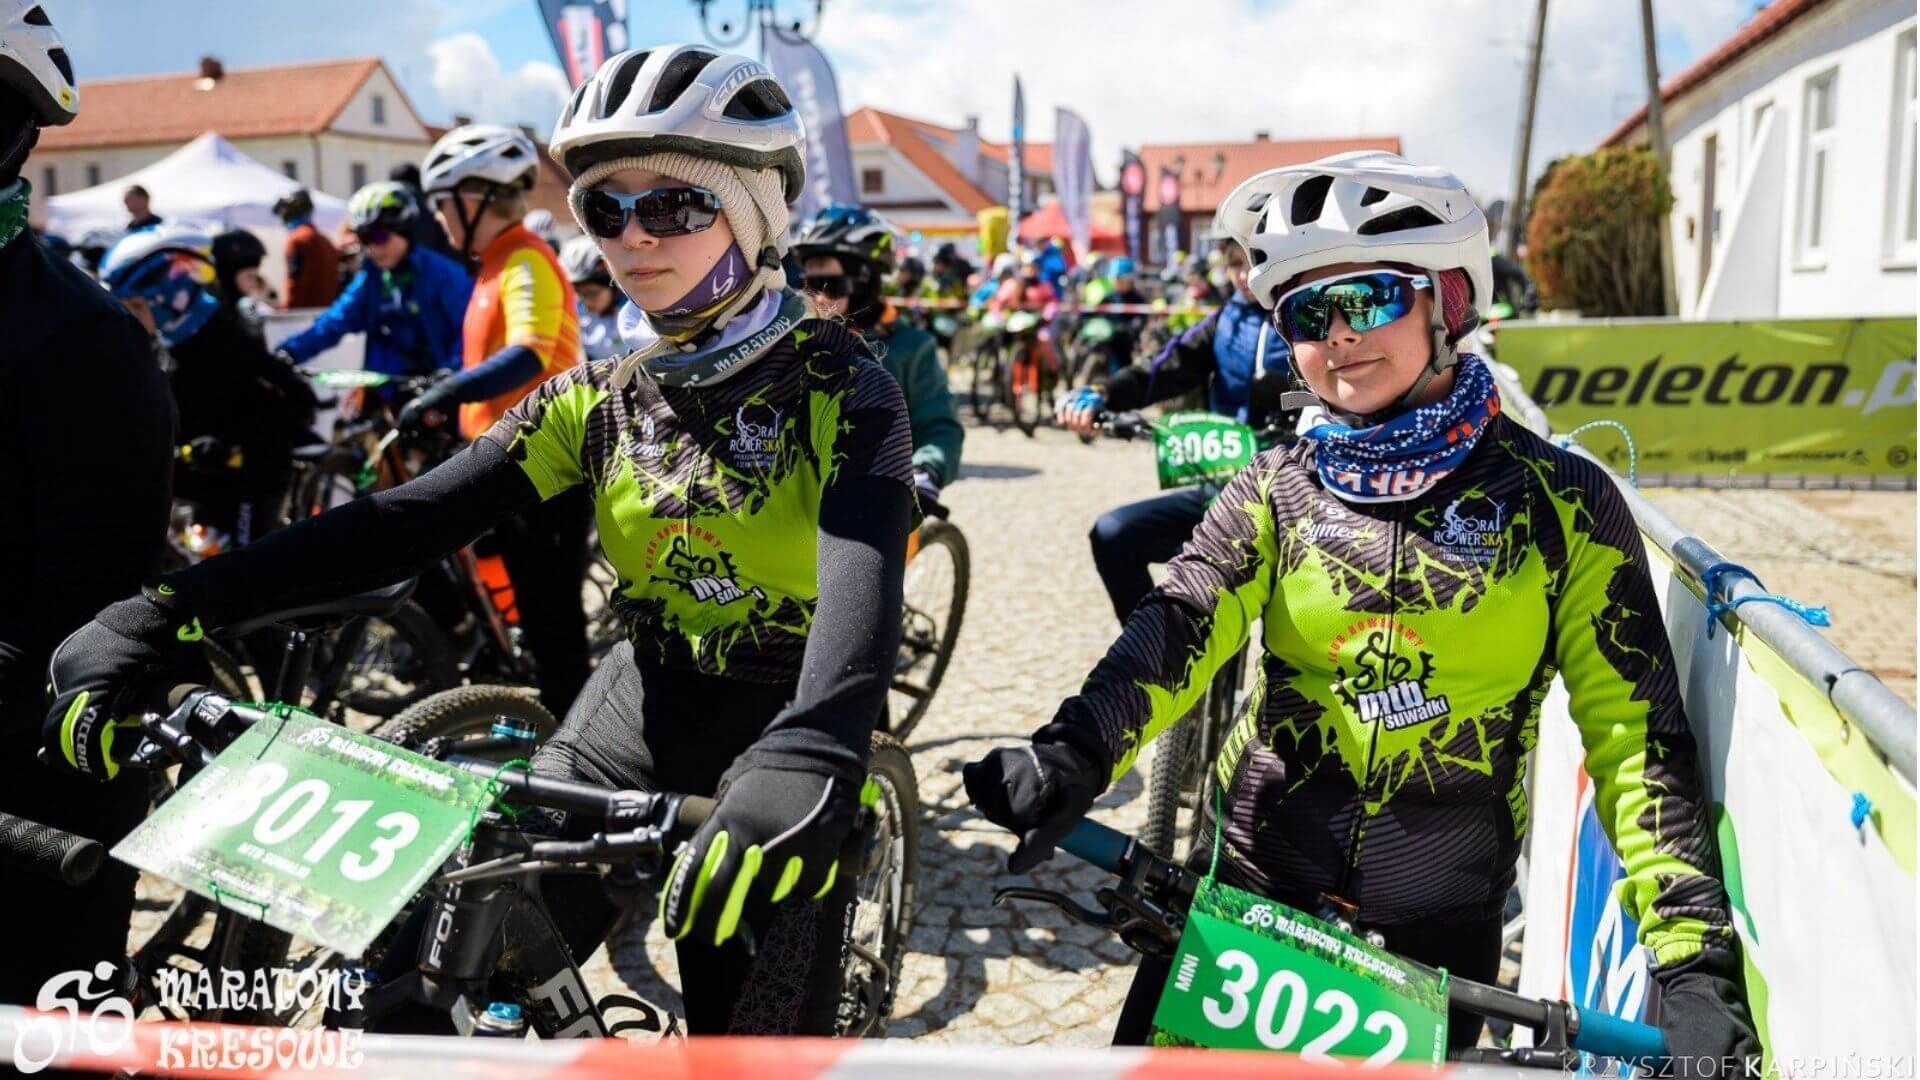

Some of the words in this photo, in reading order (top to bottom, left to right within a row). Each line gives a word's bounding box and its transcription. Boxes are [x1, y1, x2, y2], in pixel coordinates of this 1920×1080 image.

[1166, 430, 1242, 466] 3065
[1434, 531, 1504, 546] ROWERSKA
[1357, 680, 1425, 722] mtb
[1174, 953, 1199, 993] MINI
[1202, 949, 1408, 1066] 3022
